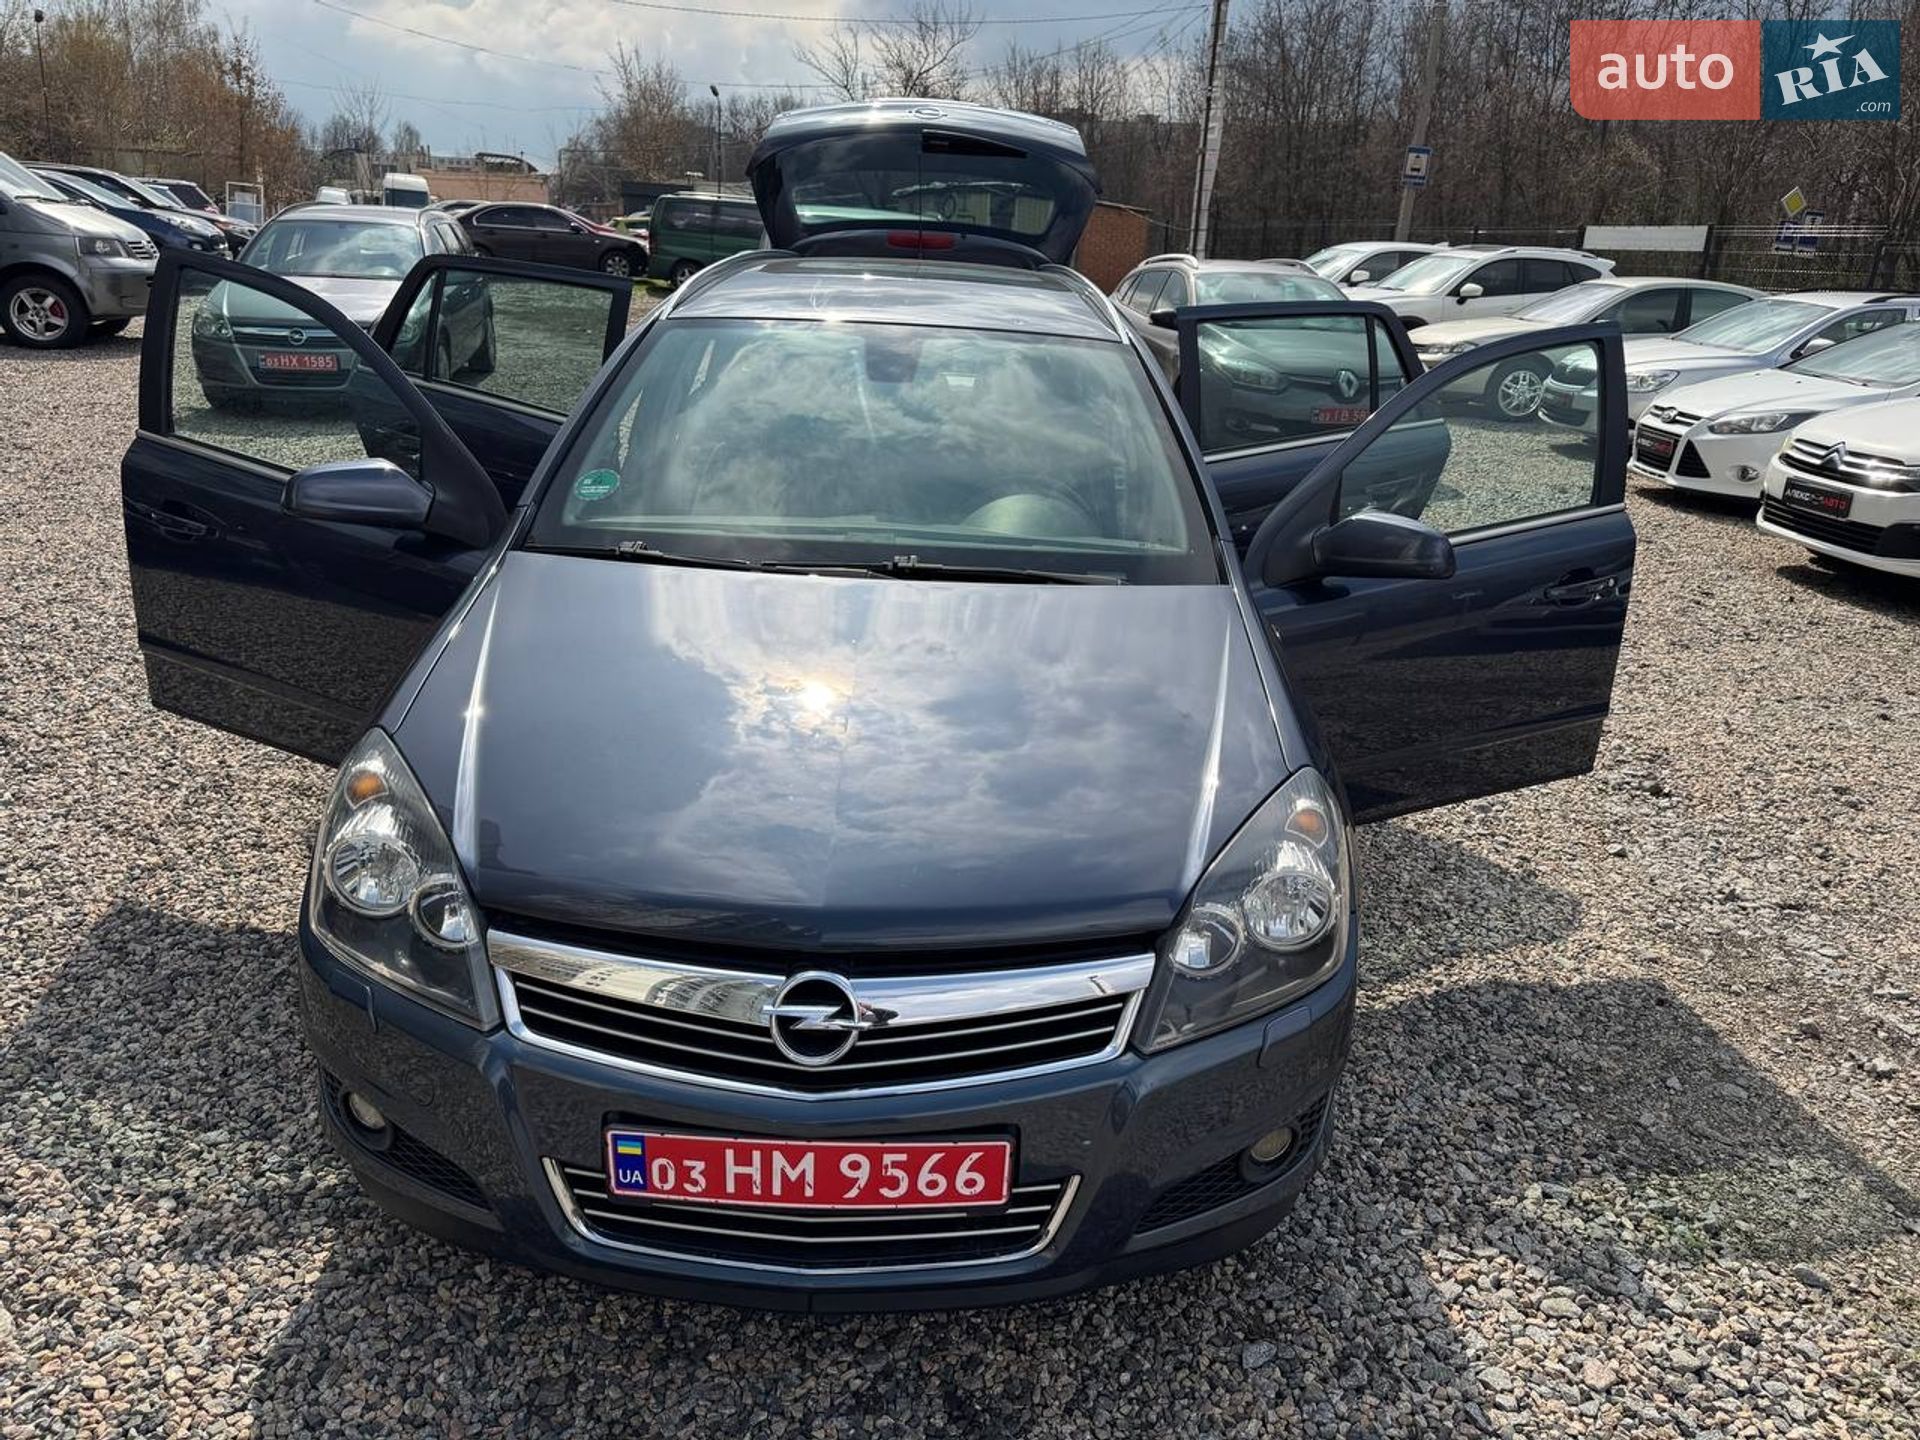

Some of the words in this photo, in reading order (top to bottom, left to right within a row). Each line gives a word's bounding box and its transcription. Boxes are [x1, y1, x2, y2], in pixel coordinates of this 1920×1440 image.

[266, 358, 279, 367] 03
[280, 355, 298, 367] HX
[303, 355, 333, 368] 1585
[618, 1169, 643, 1185] UA
[651, 1157, 706, 1193] 03
[725, 1149, 815, 1197] HM
[839, 1151, 986, 1199] 9566
